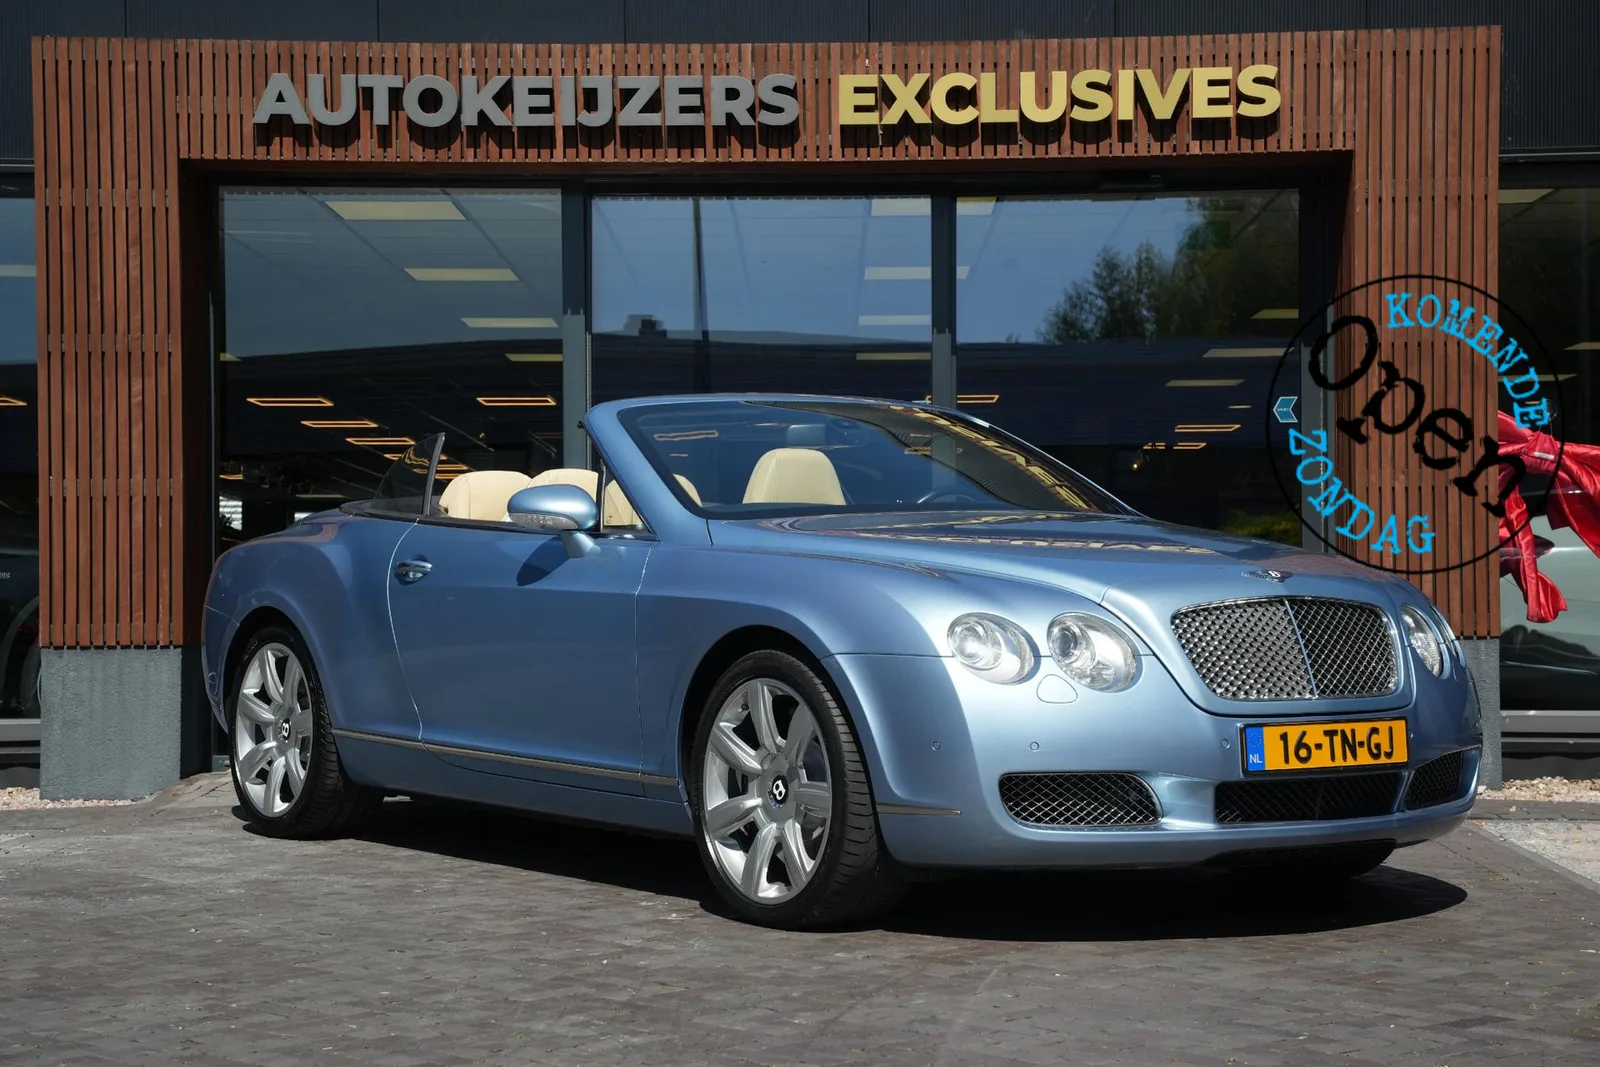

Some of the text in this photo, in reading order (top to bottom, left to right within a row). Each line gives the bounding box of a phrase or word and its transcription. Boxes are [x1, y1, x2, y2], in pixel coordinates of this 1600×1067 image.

[253, 64, 1282, 128] AUTOKEIJZERS EXCLUSIVES
[1249, 753, 1263, 764] NL
[1279, 725, 1394, 765] 16-TN-GJ
